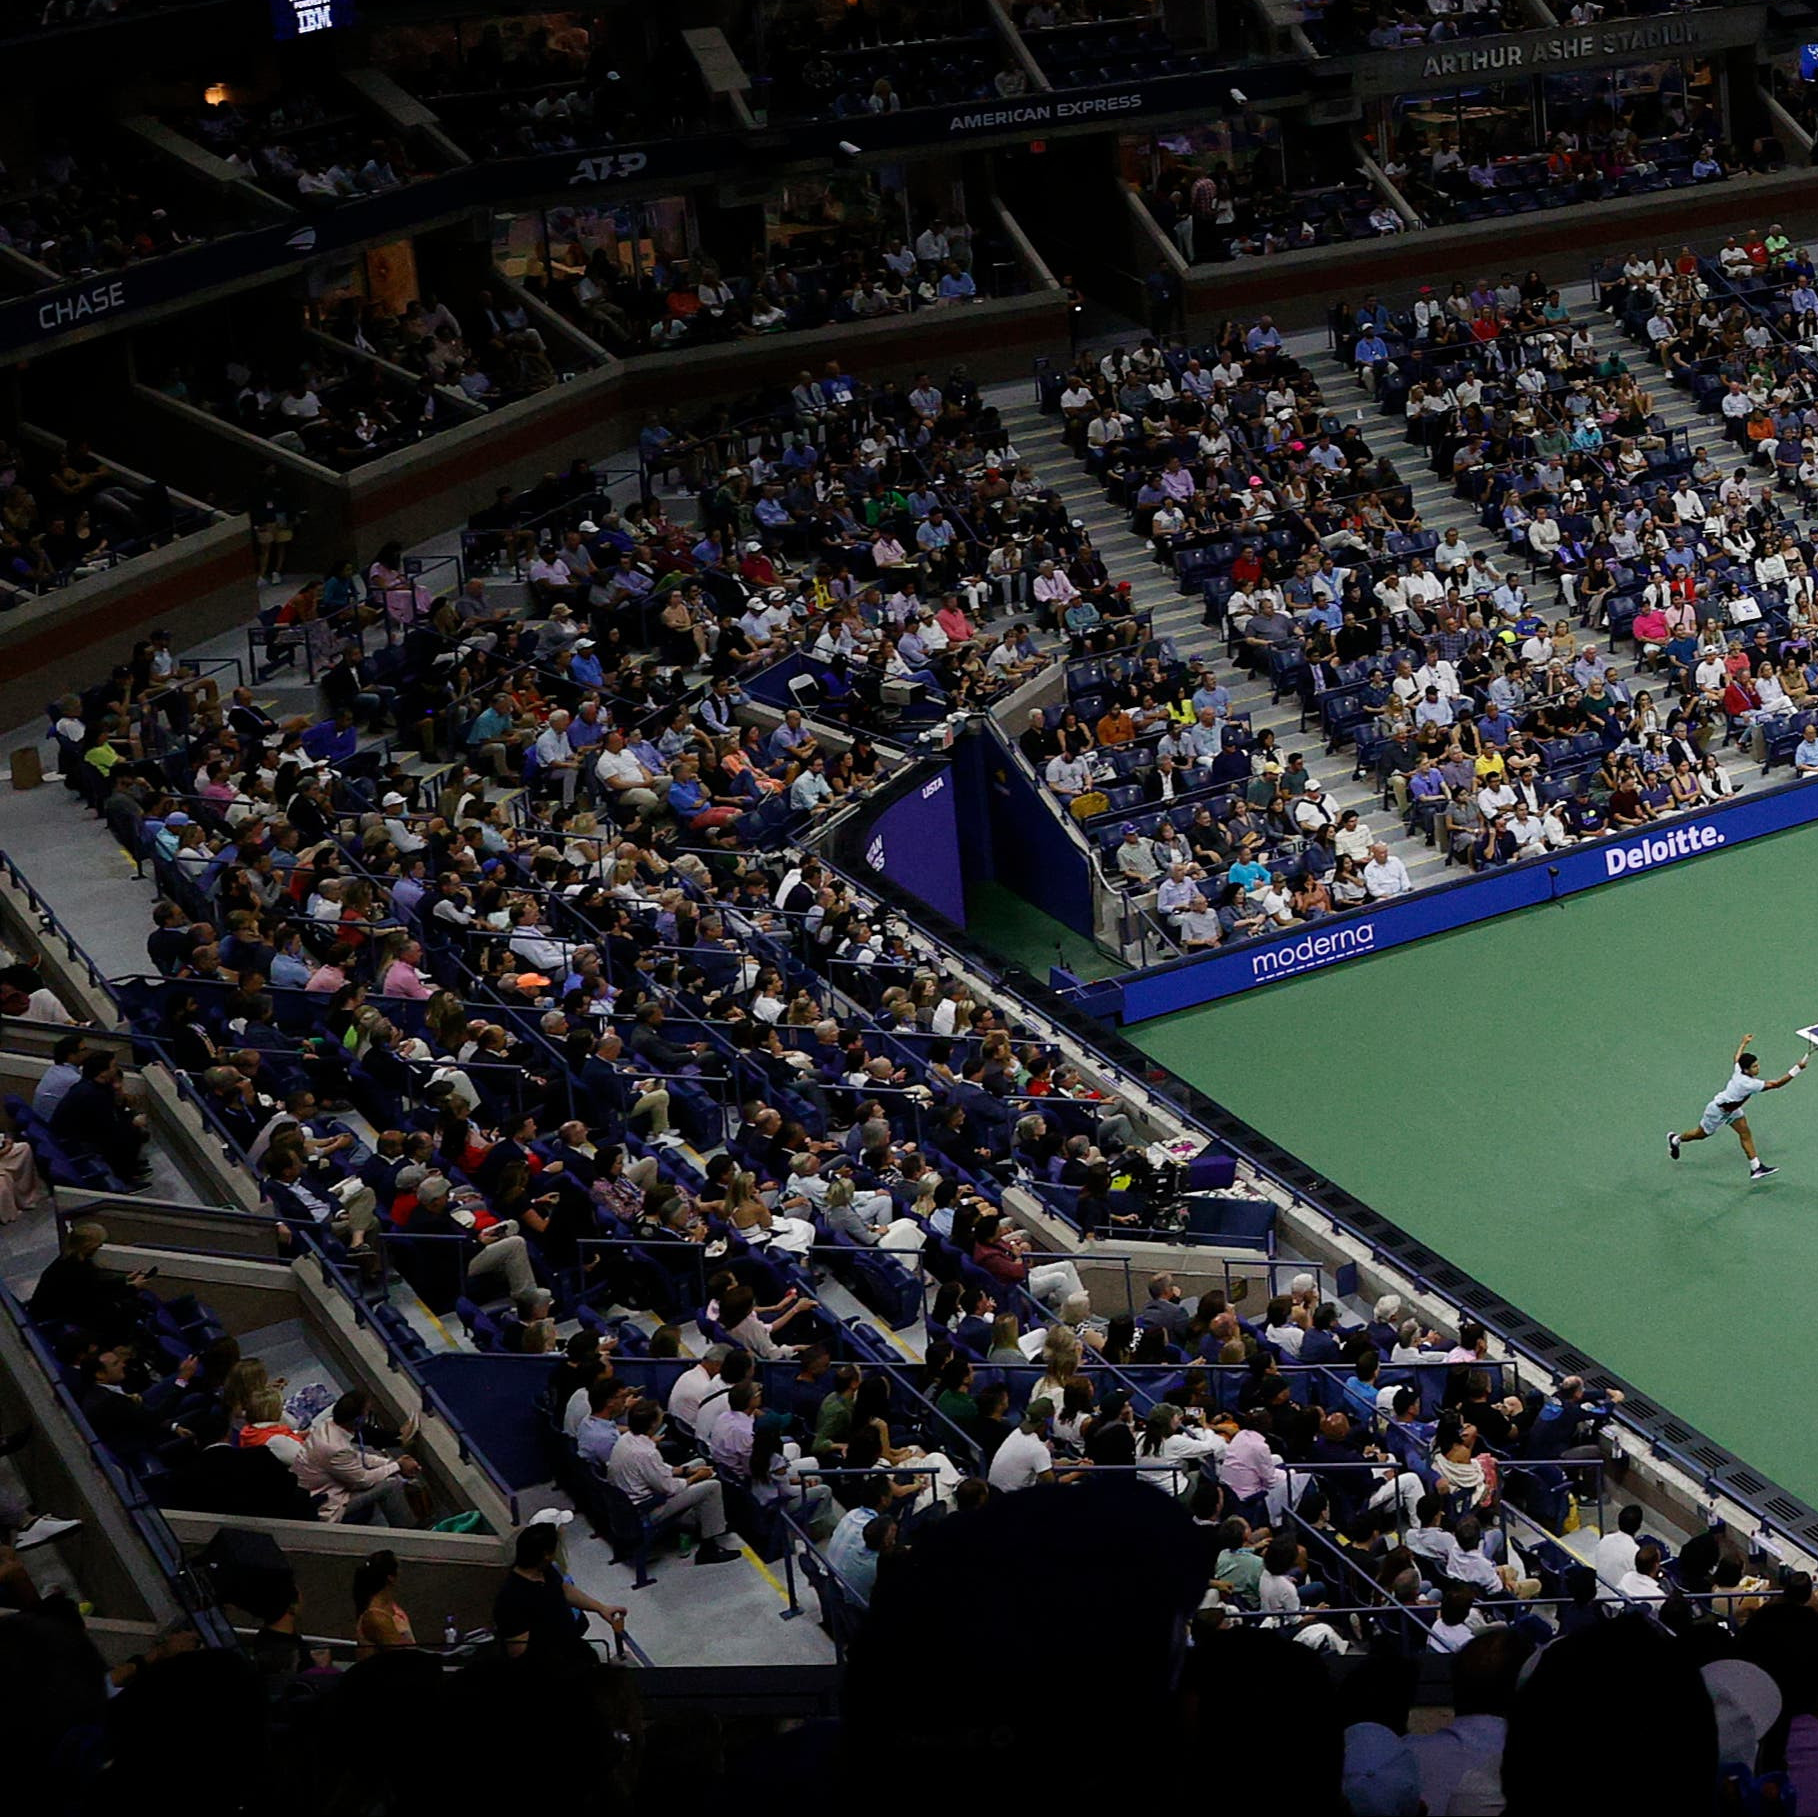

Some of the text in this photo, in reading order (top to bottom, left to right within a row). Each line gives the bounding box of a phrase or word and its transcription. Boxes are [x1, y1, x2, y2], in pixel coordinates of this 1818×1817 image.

[296, 5, 333, 34] IBM
[1422, 45, 1523, 78] ARTHUR
[1530, 37, 1593, 63] ASHE
[948, 93, 1143, 132] AMERICAN EXPRESS
[569, 152, 648, 185] ATP
[37, 282, 127, 331] CHASE
[922, 777, 944, 799] USTA
[1604, 822, 1726, 877] Deloitte.
[1251, 922, 1374, 972] moderna
